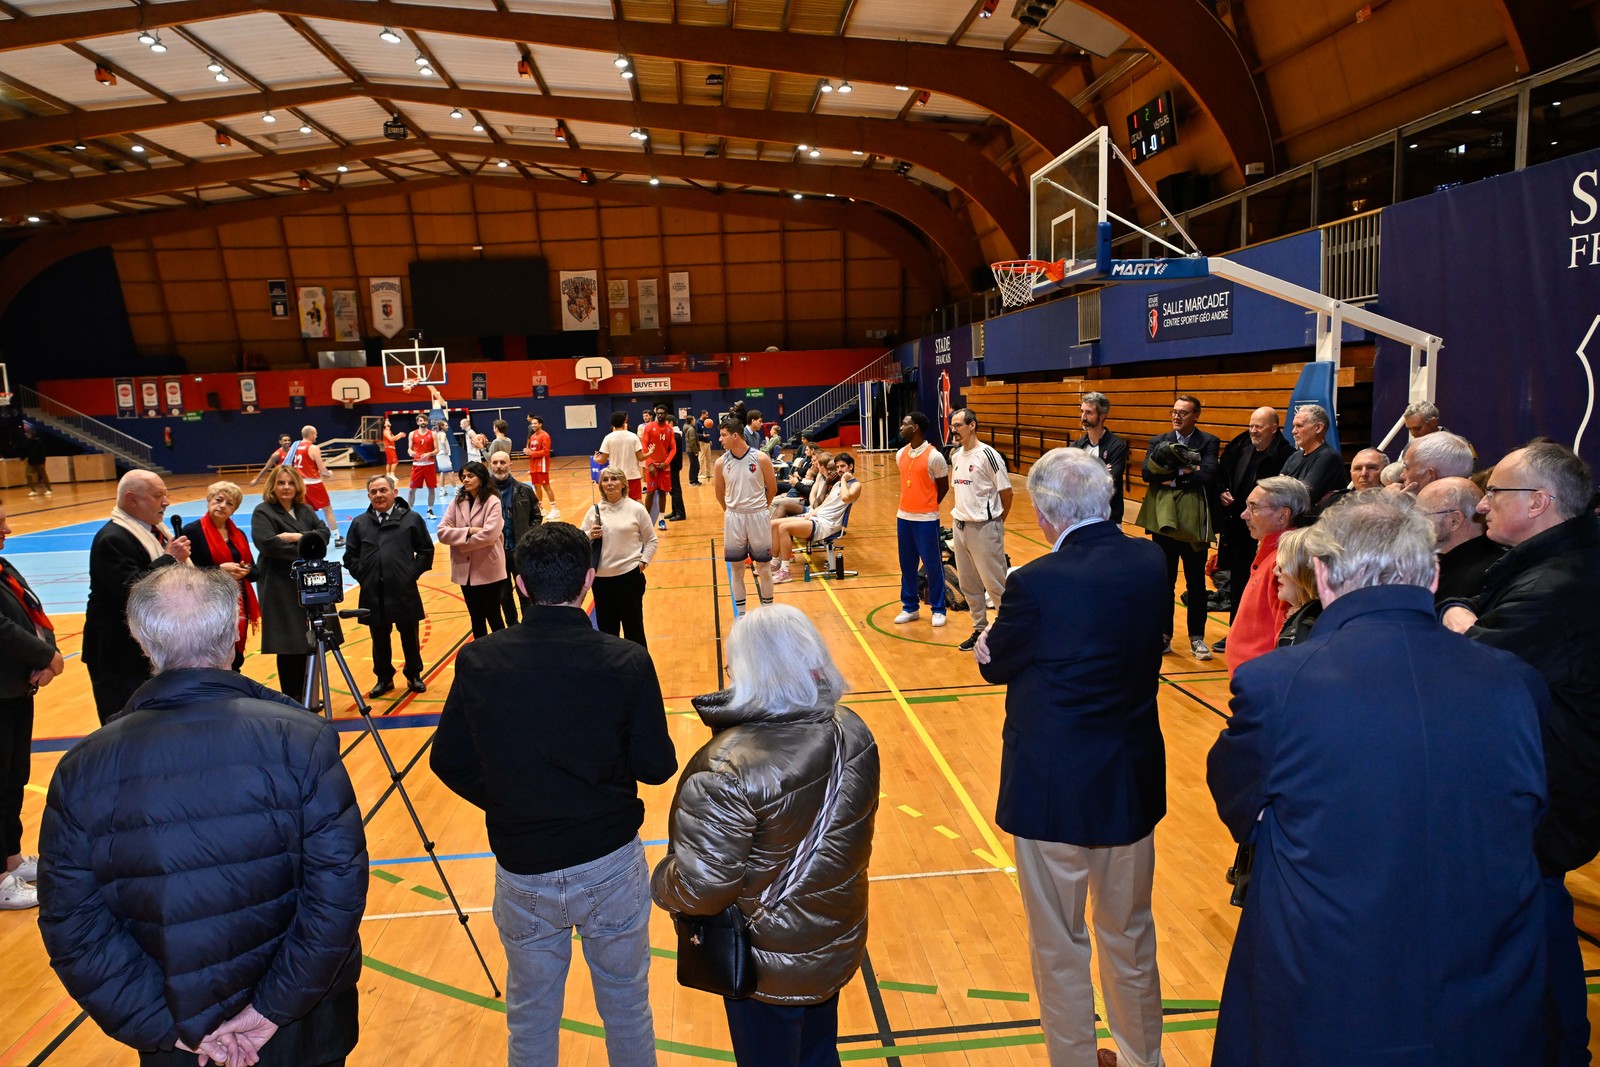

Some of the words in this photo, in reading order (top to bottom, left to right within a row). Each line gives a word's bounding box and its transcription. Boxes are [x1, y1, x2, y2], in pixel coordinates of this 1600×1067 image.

[1111, 263, 1163, 276] MARTY
[1162, 300, 1184, 317] SALLE
[1184, 291, 1230, 313] MARCADET
[1163, 317, 1180, 328] CENTRE
[1180, 314, 1198, 326] SPORTIF
[1199, 311, 1211, 323] GÉO
[1210, 308, 1229, 321] ANDRÉ
[934, 336, 951, 354] STADE
[634, 380, 669, 389] BUVETTE
[659, 433, 666, 441] 14
